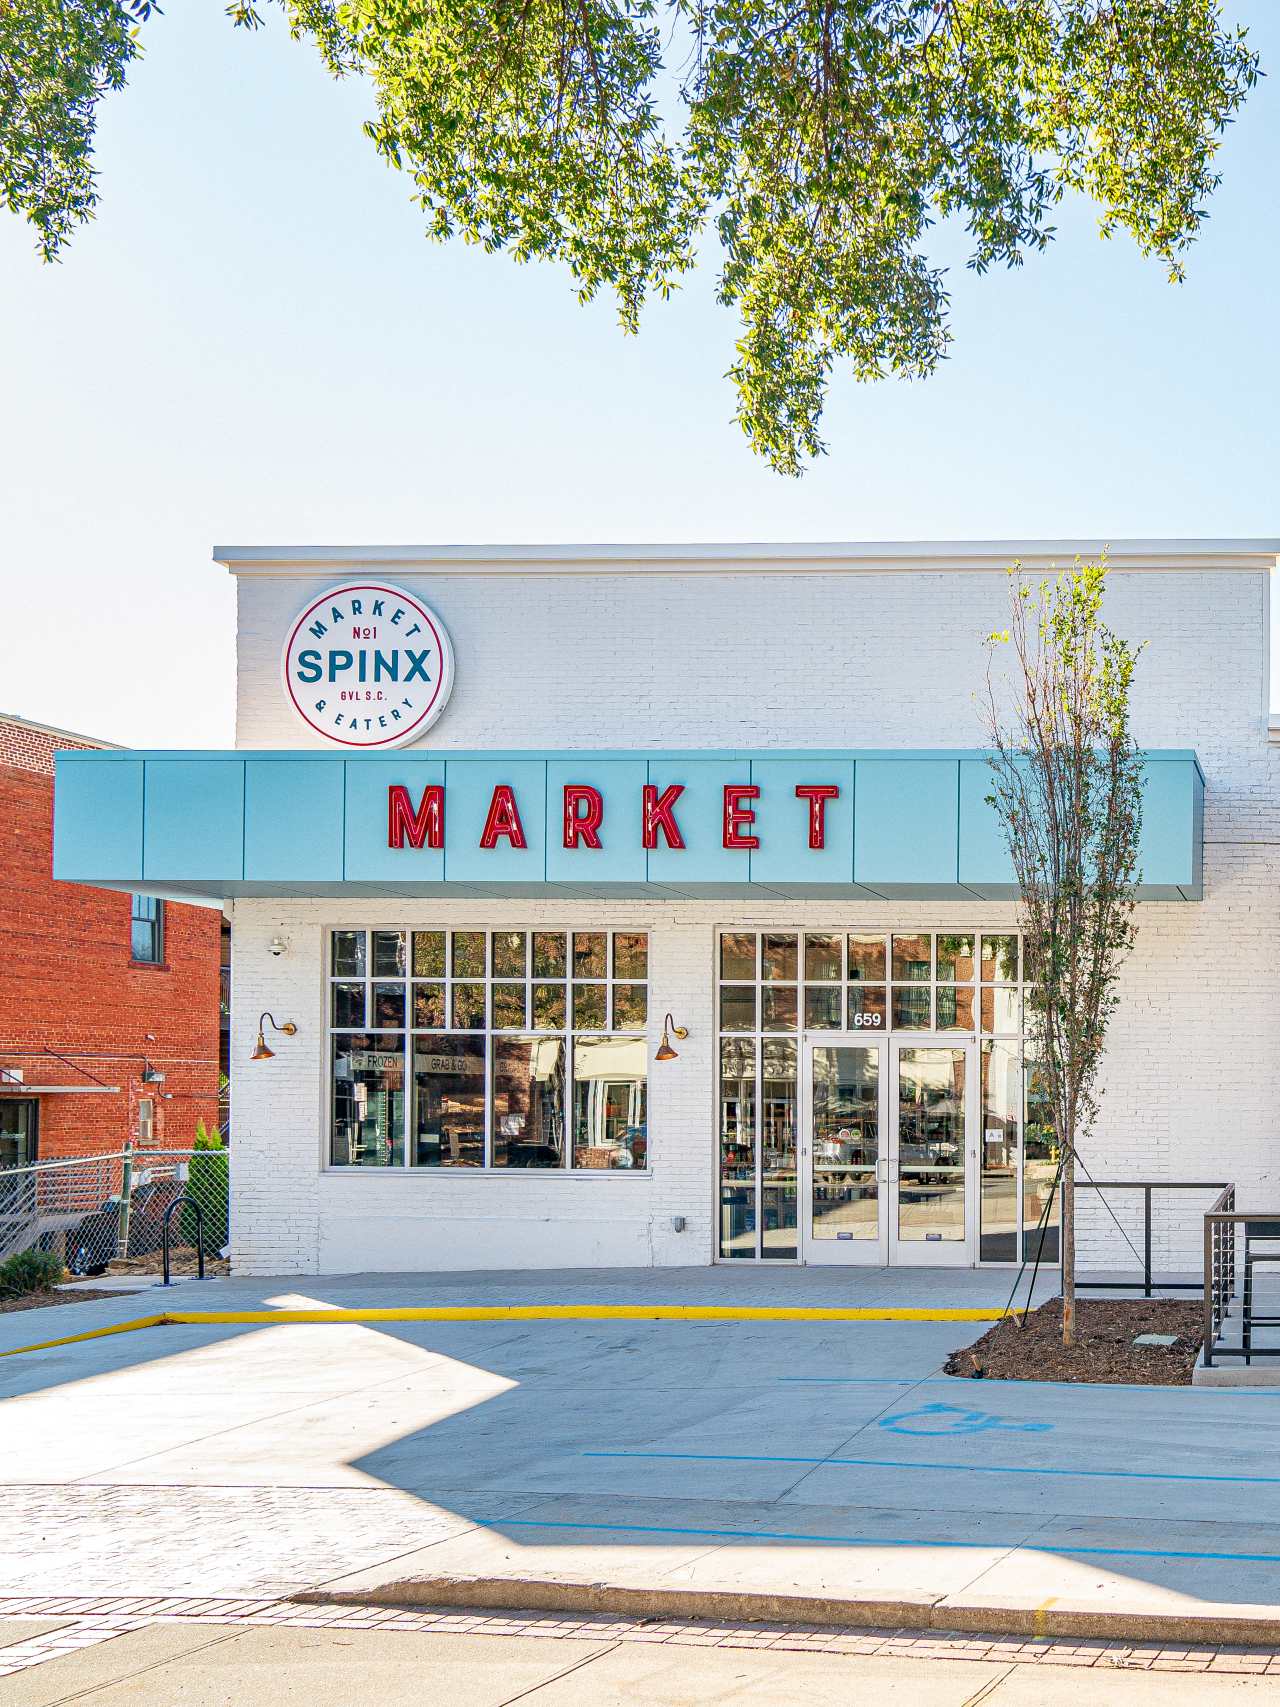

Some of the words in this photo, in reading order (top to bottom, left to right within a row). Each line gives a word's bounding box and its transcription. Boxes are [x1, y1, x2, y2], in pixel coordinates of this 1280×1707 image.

[309, 599, 421, 639] MARKET
[297, 649, 432, 683] SPINX
[340, 690, 361, 701] GVL
[315, 699, 327, 713] &
[334, 698, 414, 730] EATERY
[388, 784, 839, 850] MARKET
[854, 1012, 881, 1026] 659
[367, 1055, 398, 1068] FROZEN
